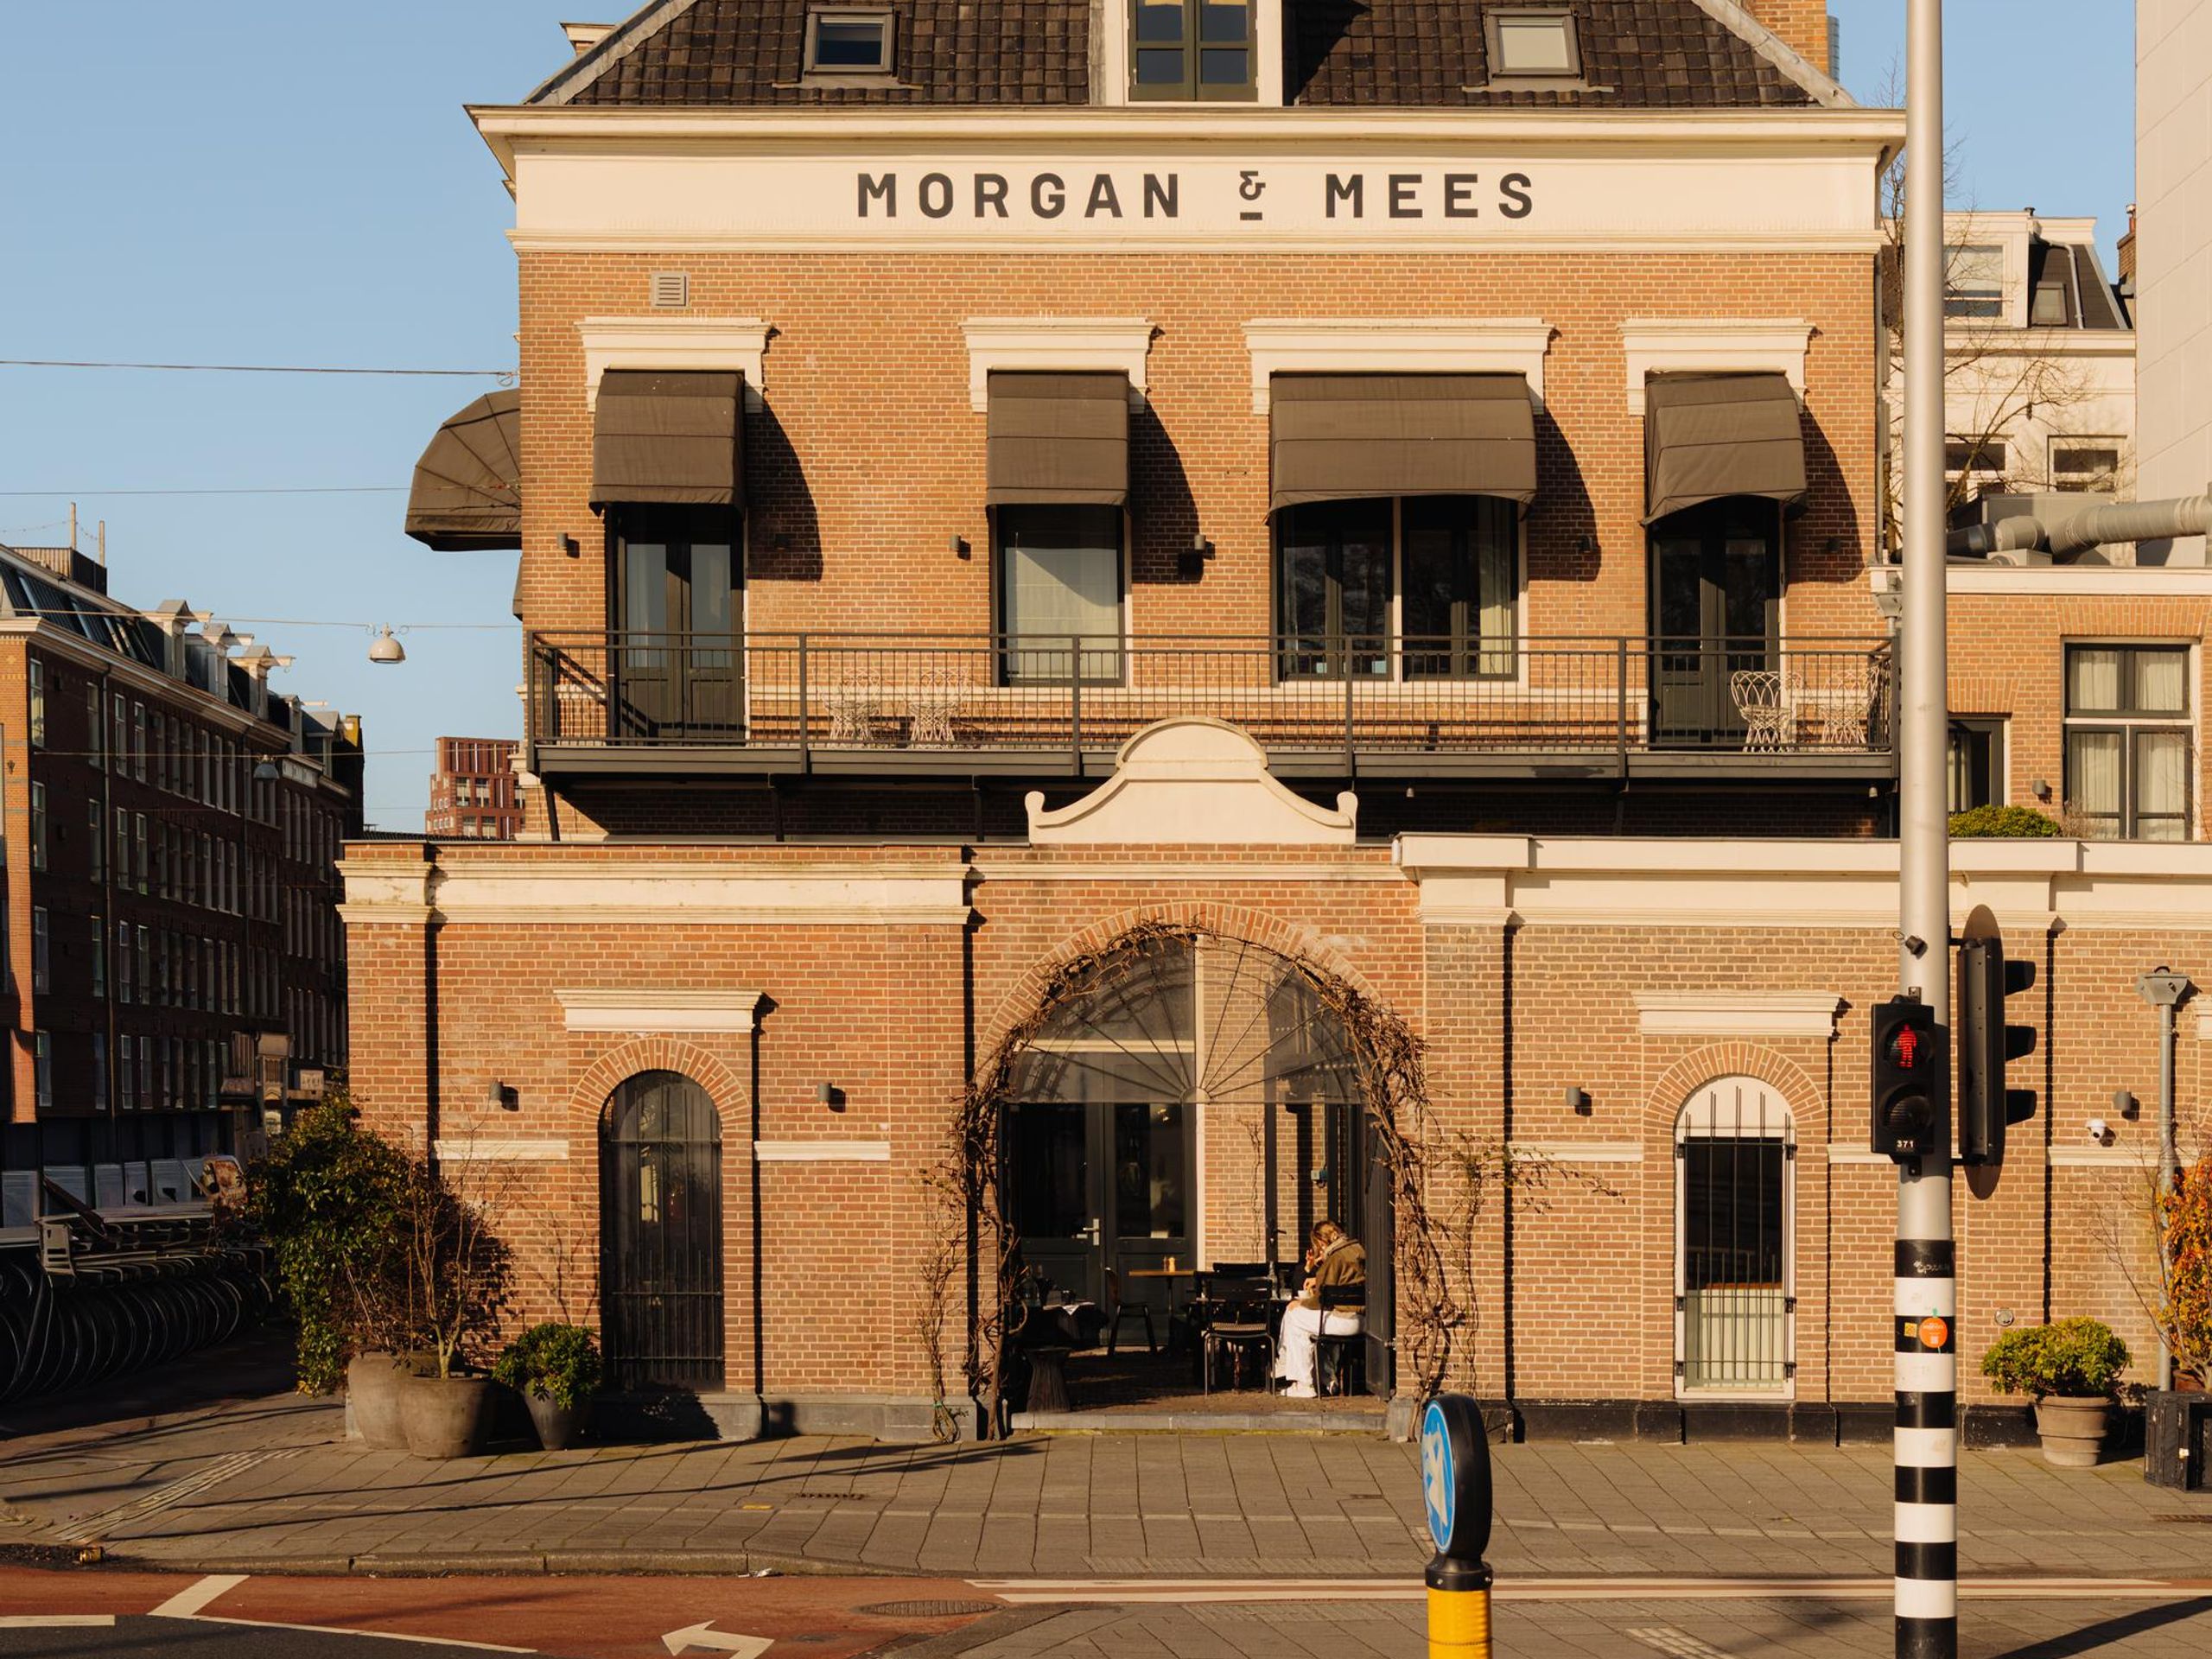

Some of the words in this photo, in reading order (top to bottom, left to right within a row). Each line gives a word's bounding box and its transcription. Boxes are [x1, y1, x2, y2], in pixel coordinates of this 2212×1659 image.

[858, 173, 1178, 219] MORGAN
[1239, 170, 1266, 221] &
[1325, 173, 1533, 219] MEES
[1897, 1140, 1914, 1148] 371
